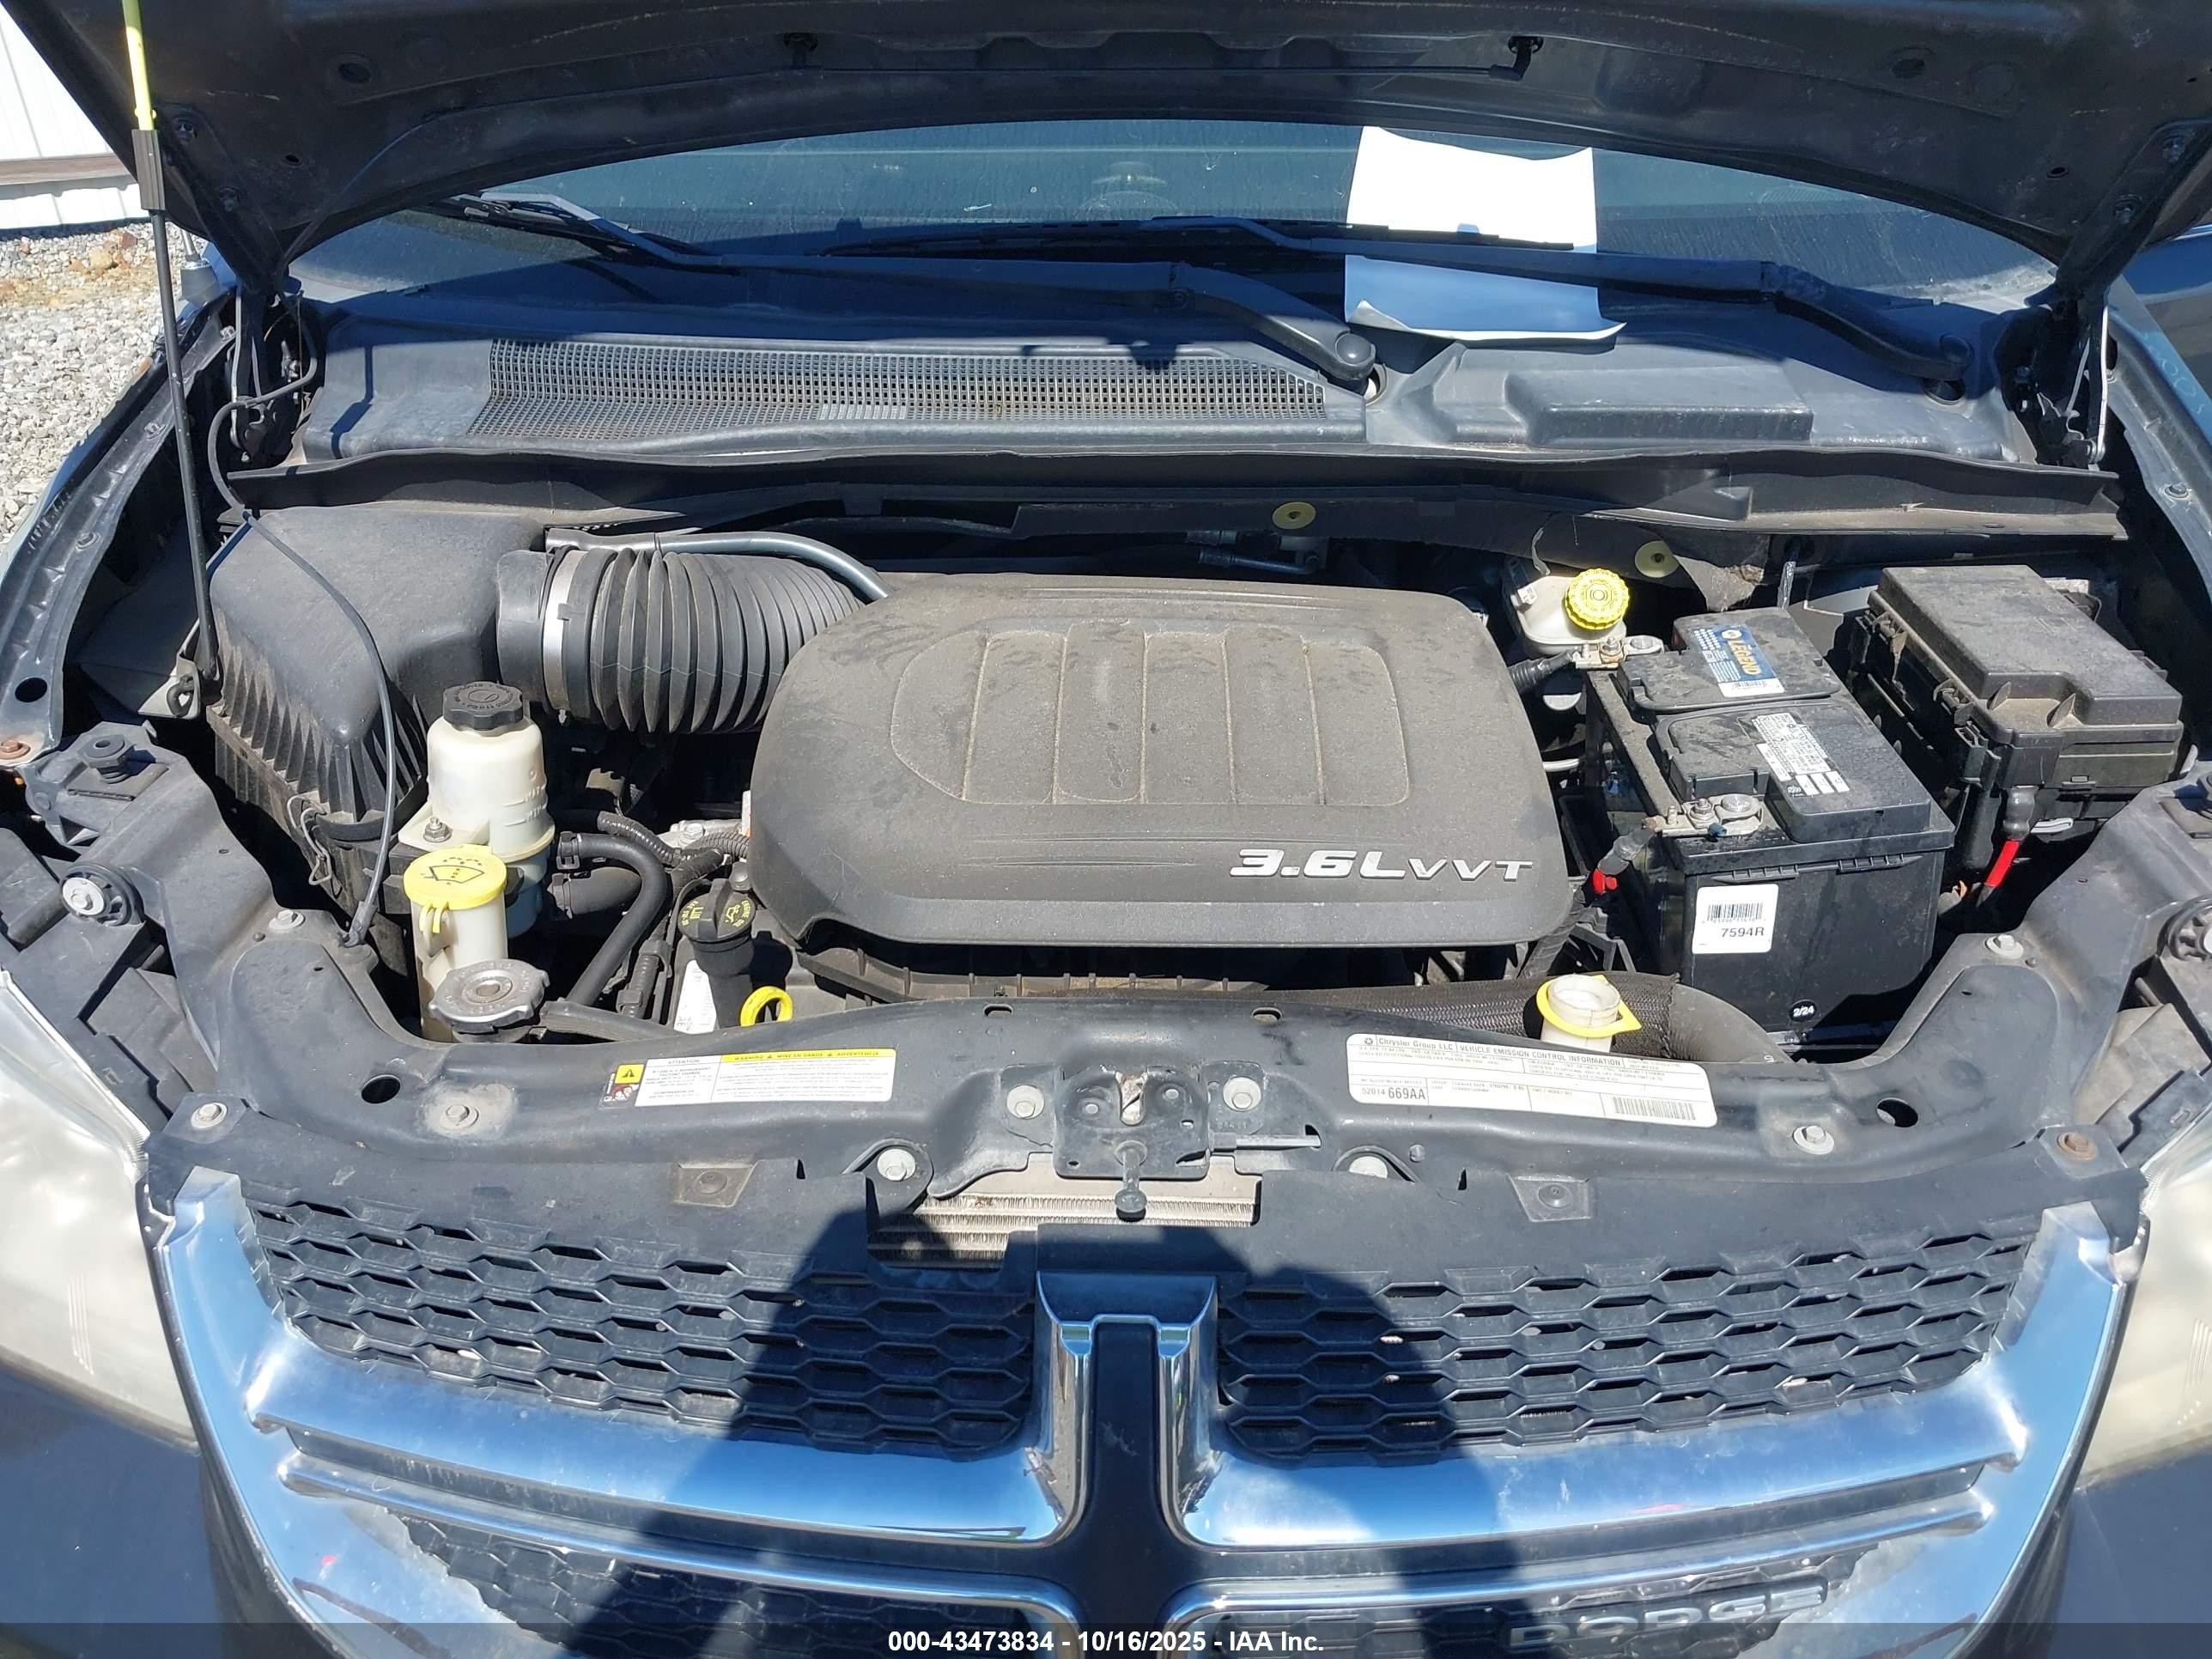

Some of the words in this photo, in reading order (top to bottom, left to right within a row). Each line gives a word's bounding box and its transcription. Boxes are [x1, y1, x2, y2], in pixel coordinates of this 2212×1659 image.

[1727, 640, 1763, 675] LEGEND
[1230, 848, 1407, 878] 3.6L
[1407, 858, 1534, 881] VVT
[1721, 927, 1765, 938] 7594R
[1793, 1006, 1814, 1018] 2/24
[1378, 1037, 1411, 1047] Chrysler
[1413, 1040, 1437, 1050] Group
[1459, 1045, 1492, 1054] VEHICLE
[1493, 1048, 1530, 1058] EMISSION
[1531, 1052, 1567, 1062] CONTROL
[1569, 1055, 1621, 1066] INFORMATION
[1388, 1087, 1426, 1100] 669AA
[1510, 1585, 1825, 1649] DODGE
